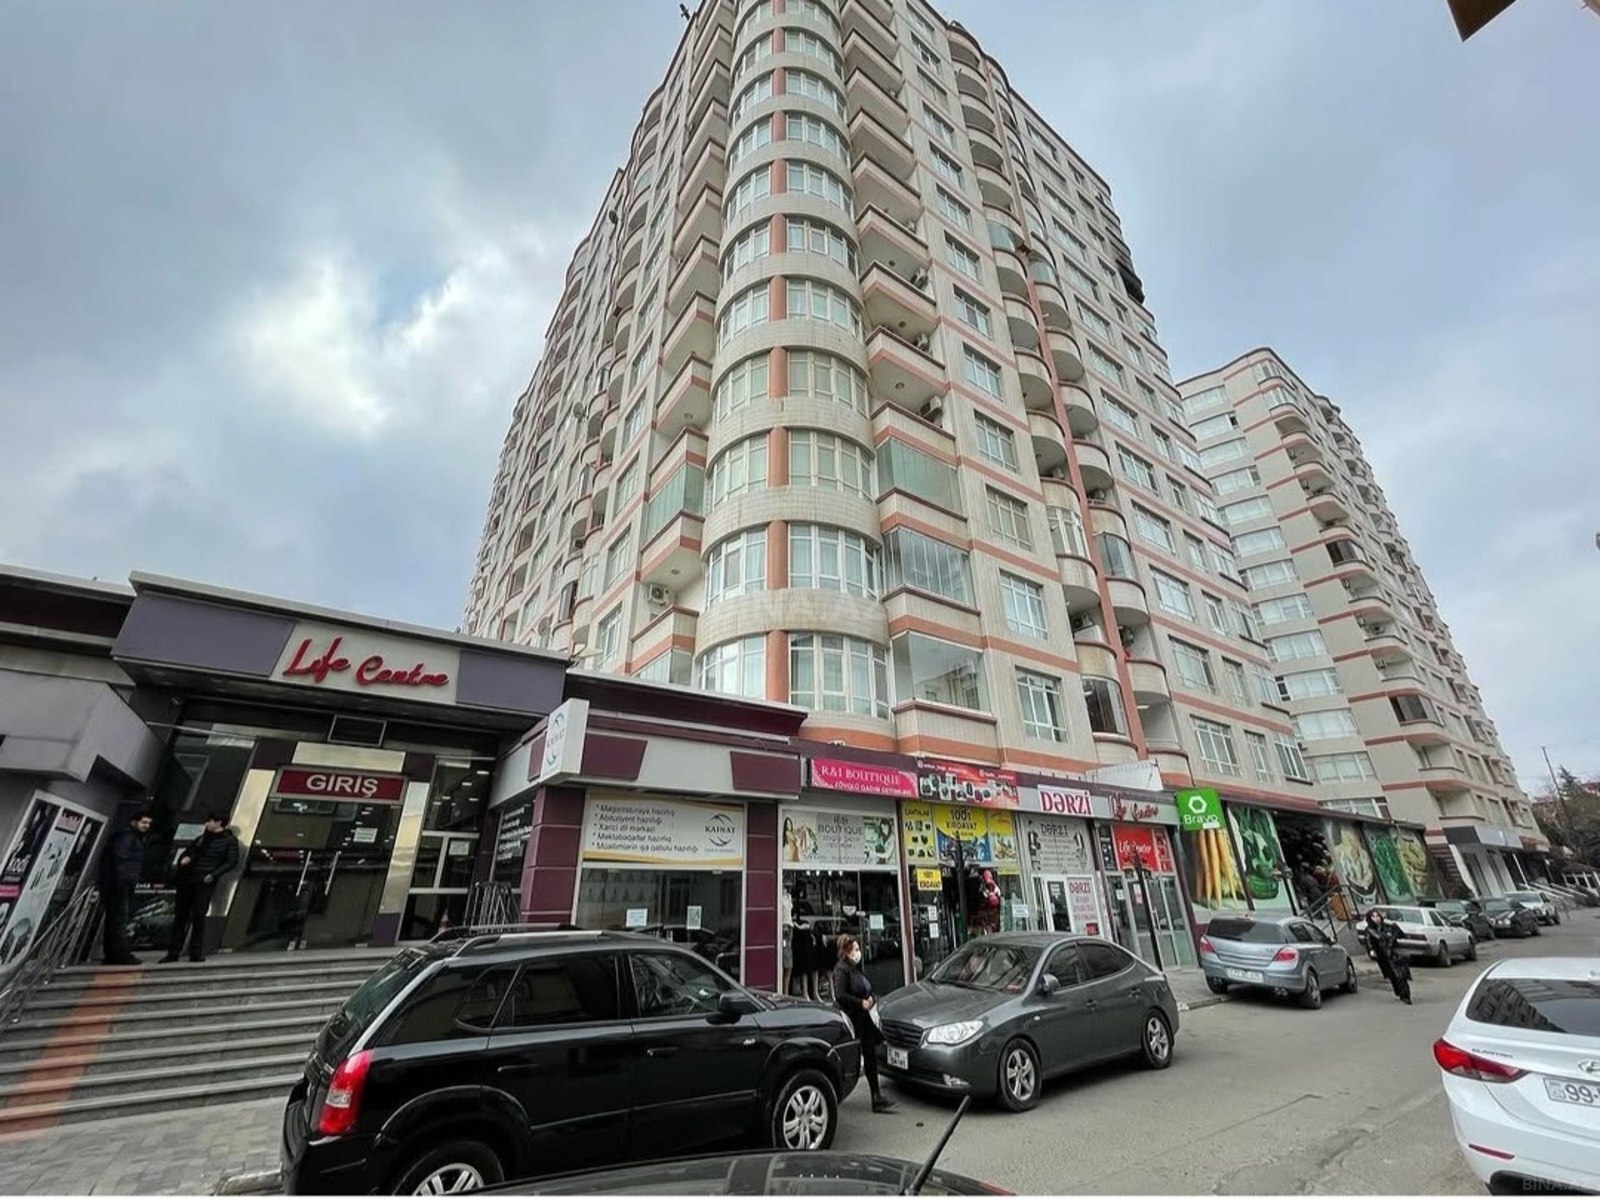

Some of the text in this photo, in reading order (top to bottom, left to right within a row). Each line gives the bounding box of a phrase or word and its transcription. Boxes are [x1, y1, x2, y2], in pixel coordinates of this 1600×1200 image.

[283, 637, 449, 686] Life Centre
[306, 773, 378, 798] GİRİŞ
[845, 768, 901, 785] BOUTIQUE
[1040, 791, 1092, 815] DƏRZİ
[1183, 814, 1218, 825] Bravo
[1564, 1083, 1600, 1104] 99-
